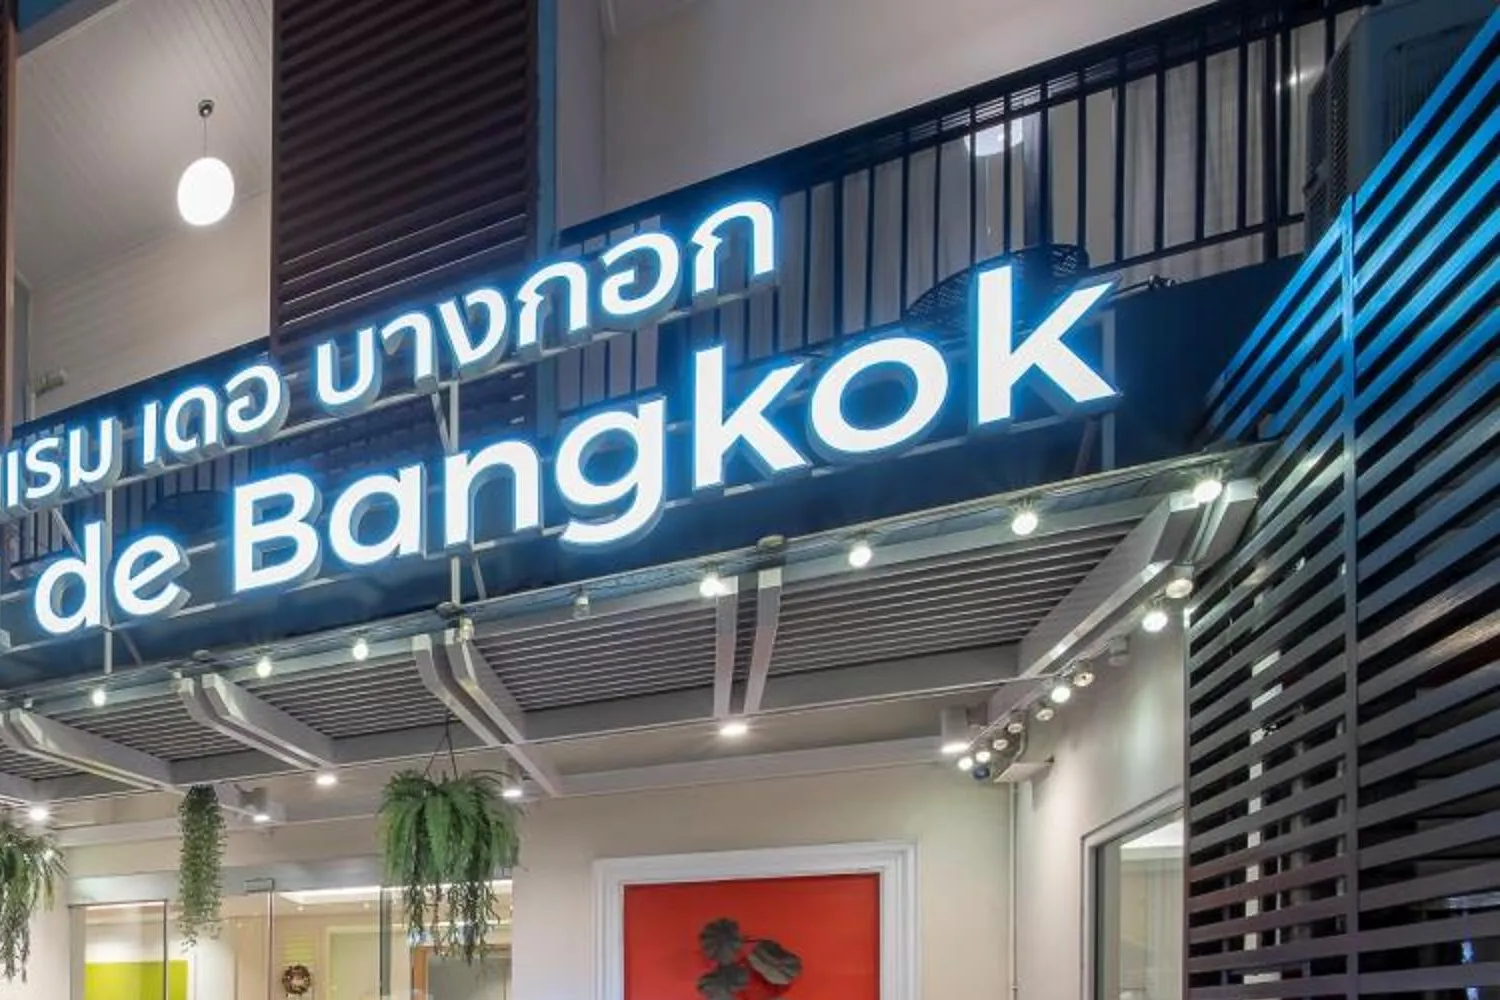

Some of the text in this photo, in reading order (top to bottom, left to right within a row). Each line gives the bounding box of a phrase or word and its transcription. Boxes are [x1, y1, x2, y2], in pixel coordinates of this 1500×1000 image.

[35, 521, 182, 634] de
[233, 264, 1122, 592] Bangkok
[143, 364, 285, 464] เดอ
[315, 199, 776, 406] บางกอก
